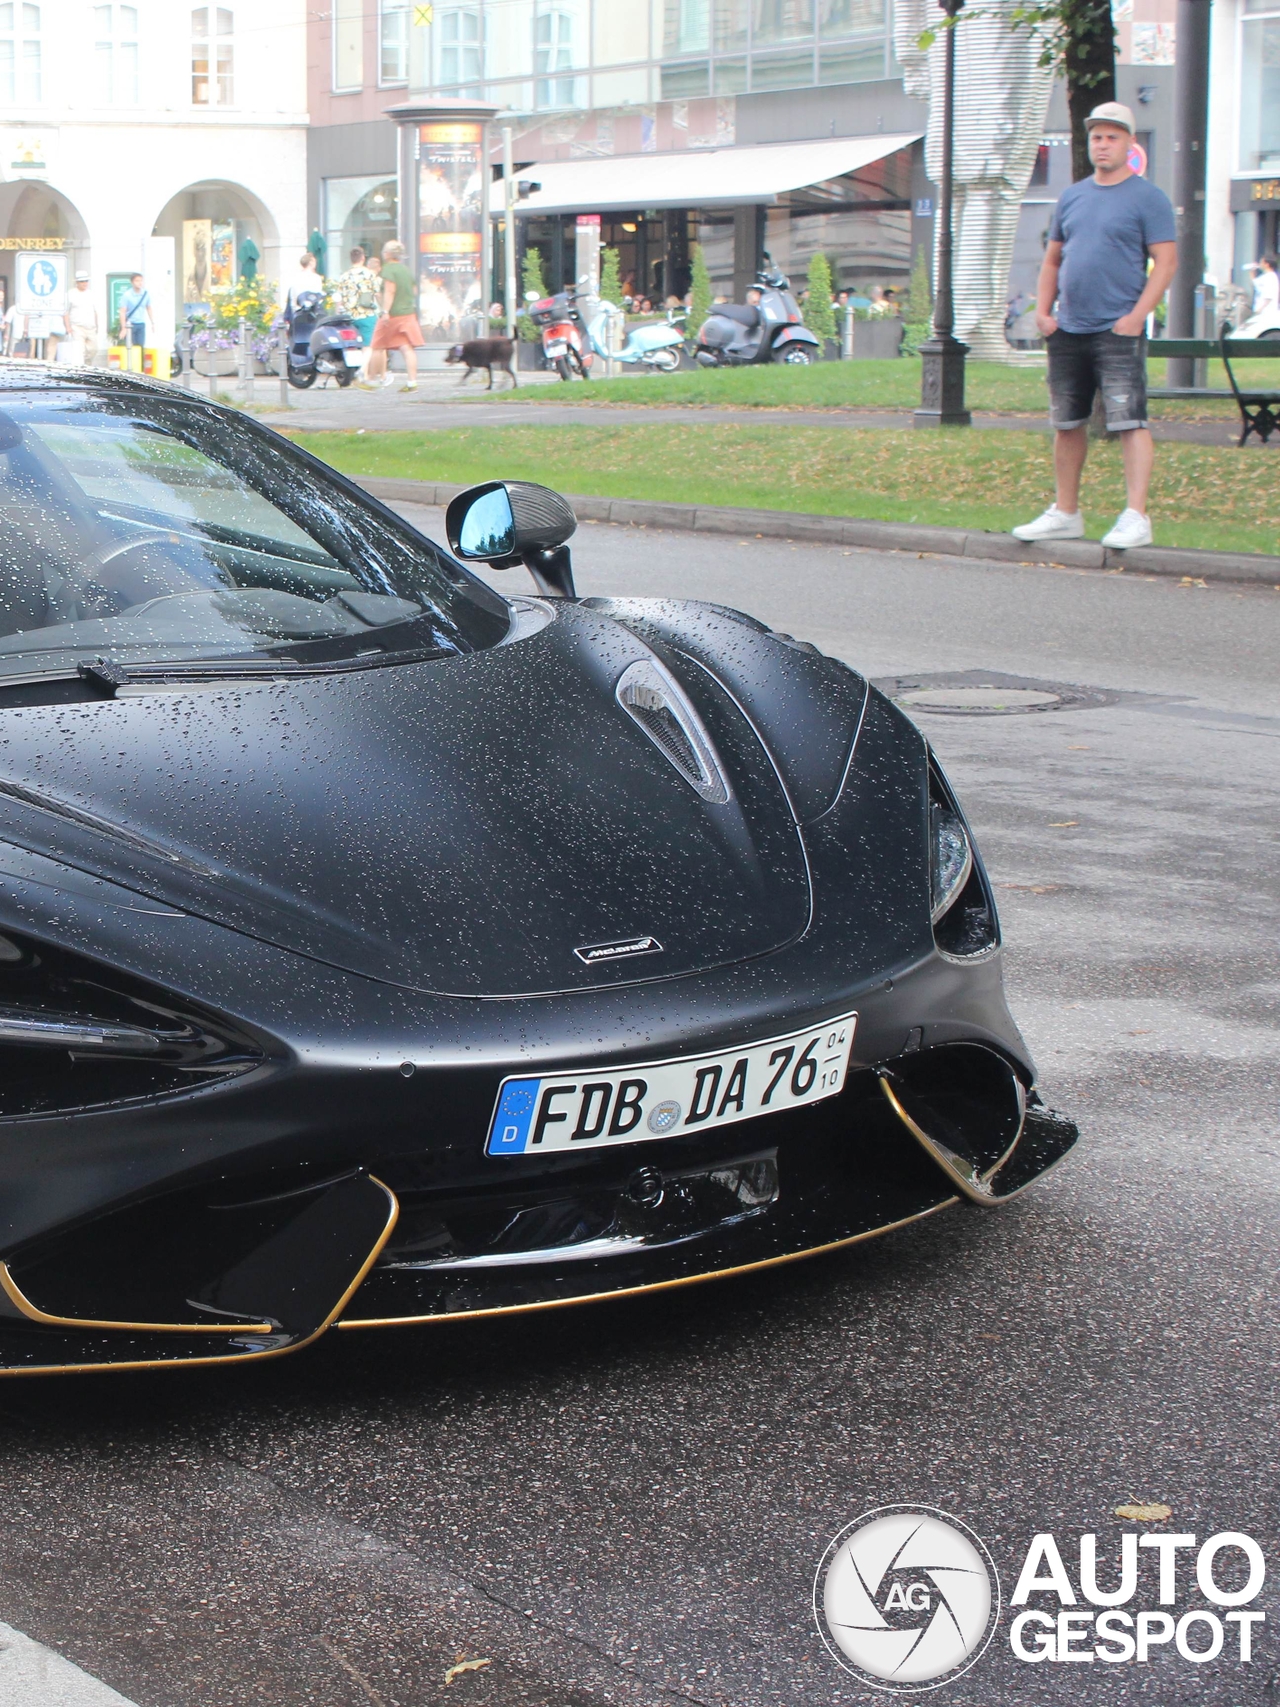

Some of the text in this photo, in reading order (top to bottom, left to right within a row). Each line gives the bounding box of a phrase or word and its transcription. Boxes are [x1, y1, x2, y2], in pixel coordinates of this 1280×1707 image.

[587, 942, 651, 958] McLaren
[827, 1027, 845, 1049] 04
[502, 1126, 517, 1143] D
[532, 1079, 648, 1144] FDB
[685, 1058, 748, 1125] DA
[761, 1037, 821, 1106] 76
[821, 1072, 838, 1090] 10
